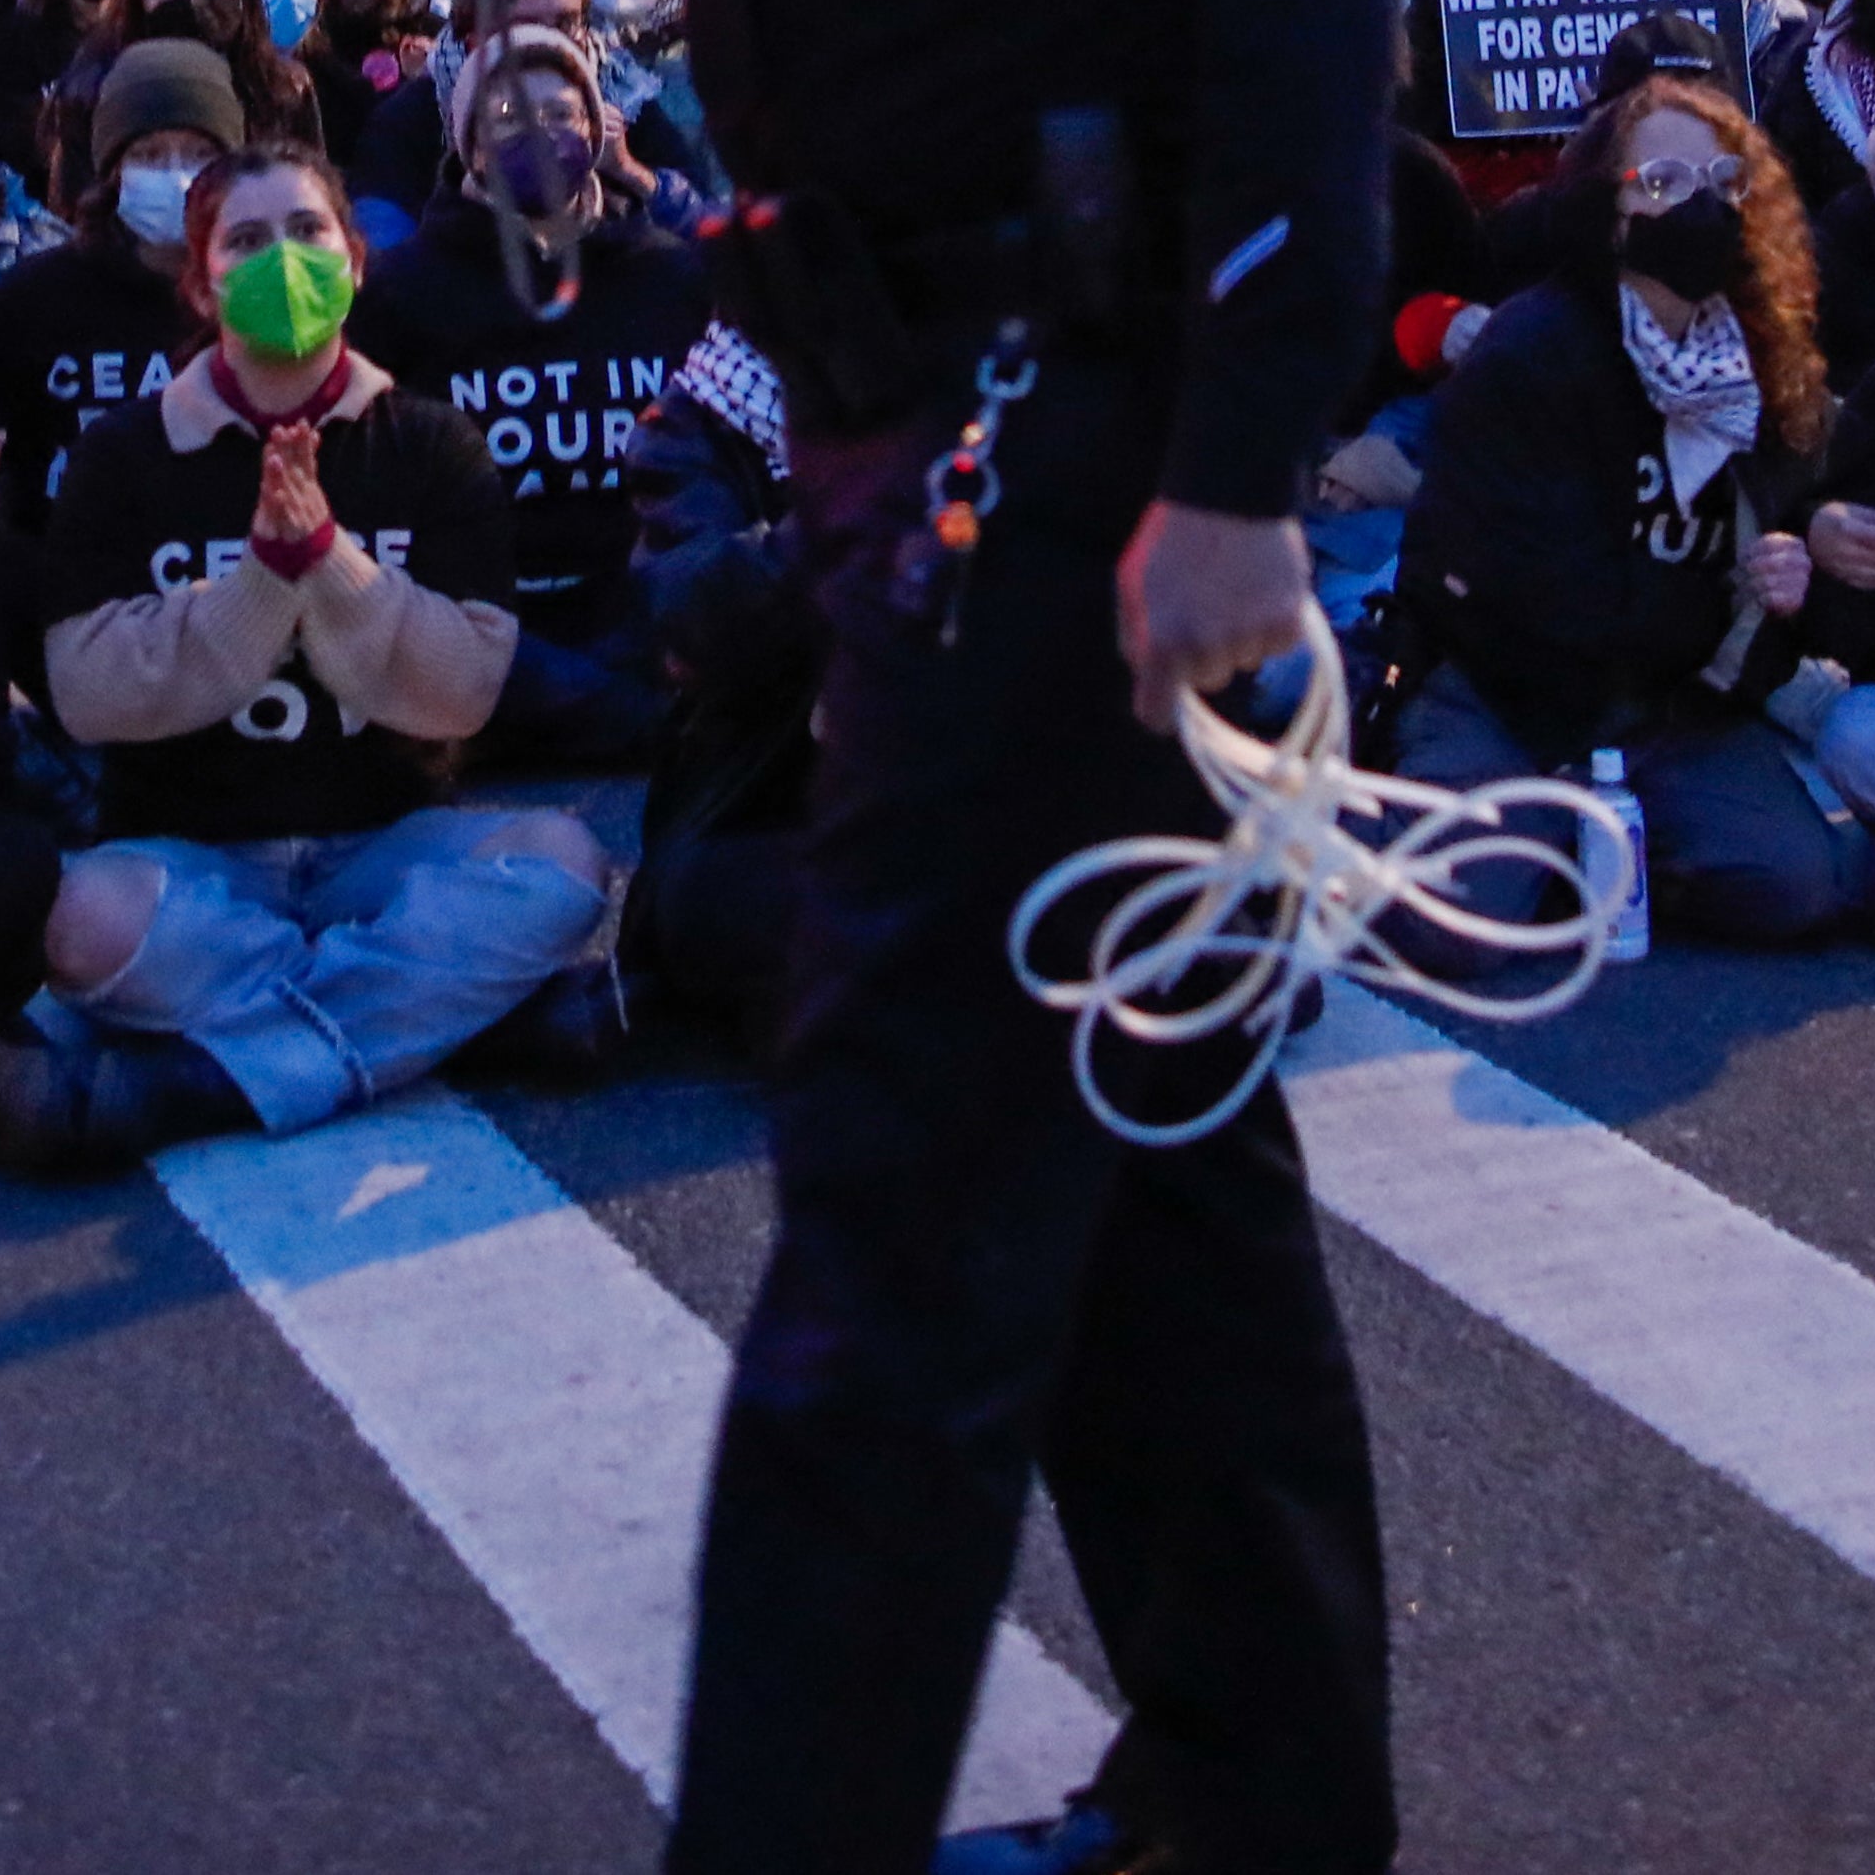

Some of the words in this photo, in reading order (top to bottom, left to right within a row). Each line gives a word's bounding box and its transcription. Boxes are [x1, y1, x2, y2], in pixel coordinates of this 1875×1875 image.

[1477, 17, 1545, 61] FOR
[1493, 69, 1528, 112] IN
[47, 349, 174, 401] CEA
[450, 359, 579, 413] NOT
[606, 355, 665, 400] IN
[486, 408, 637, 468] OUR
